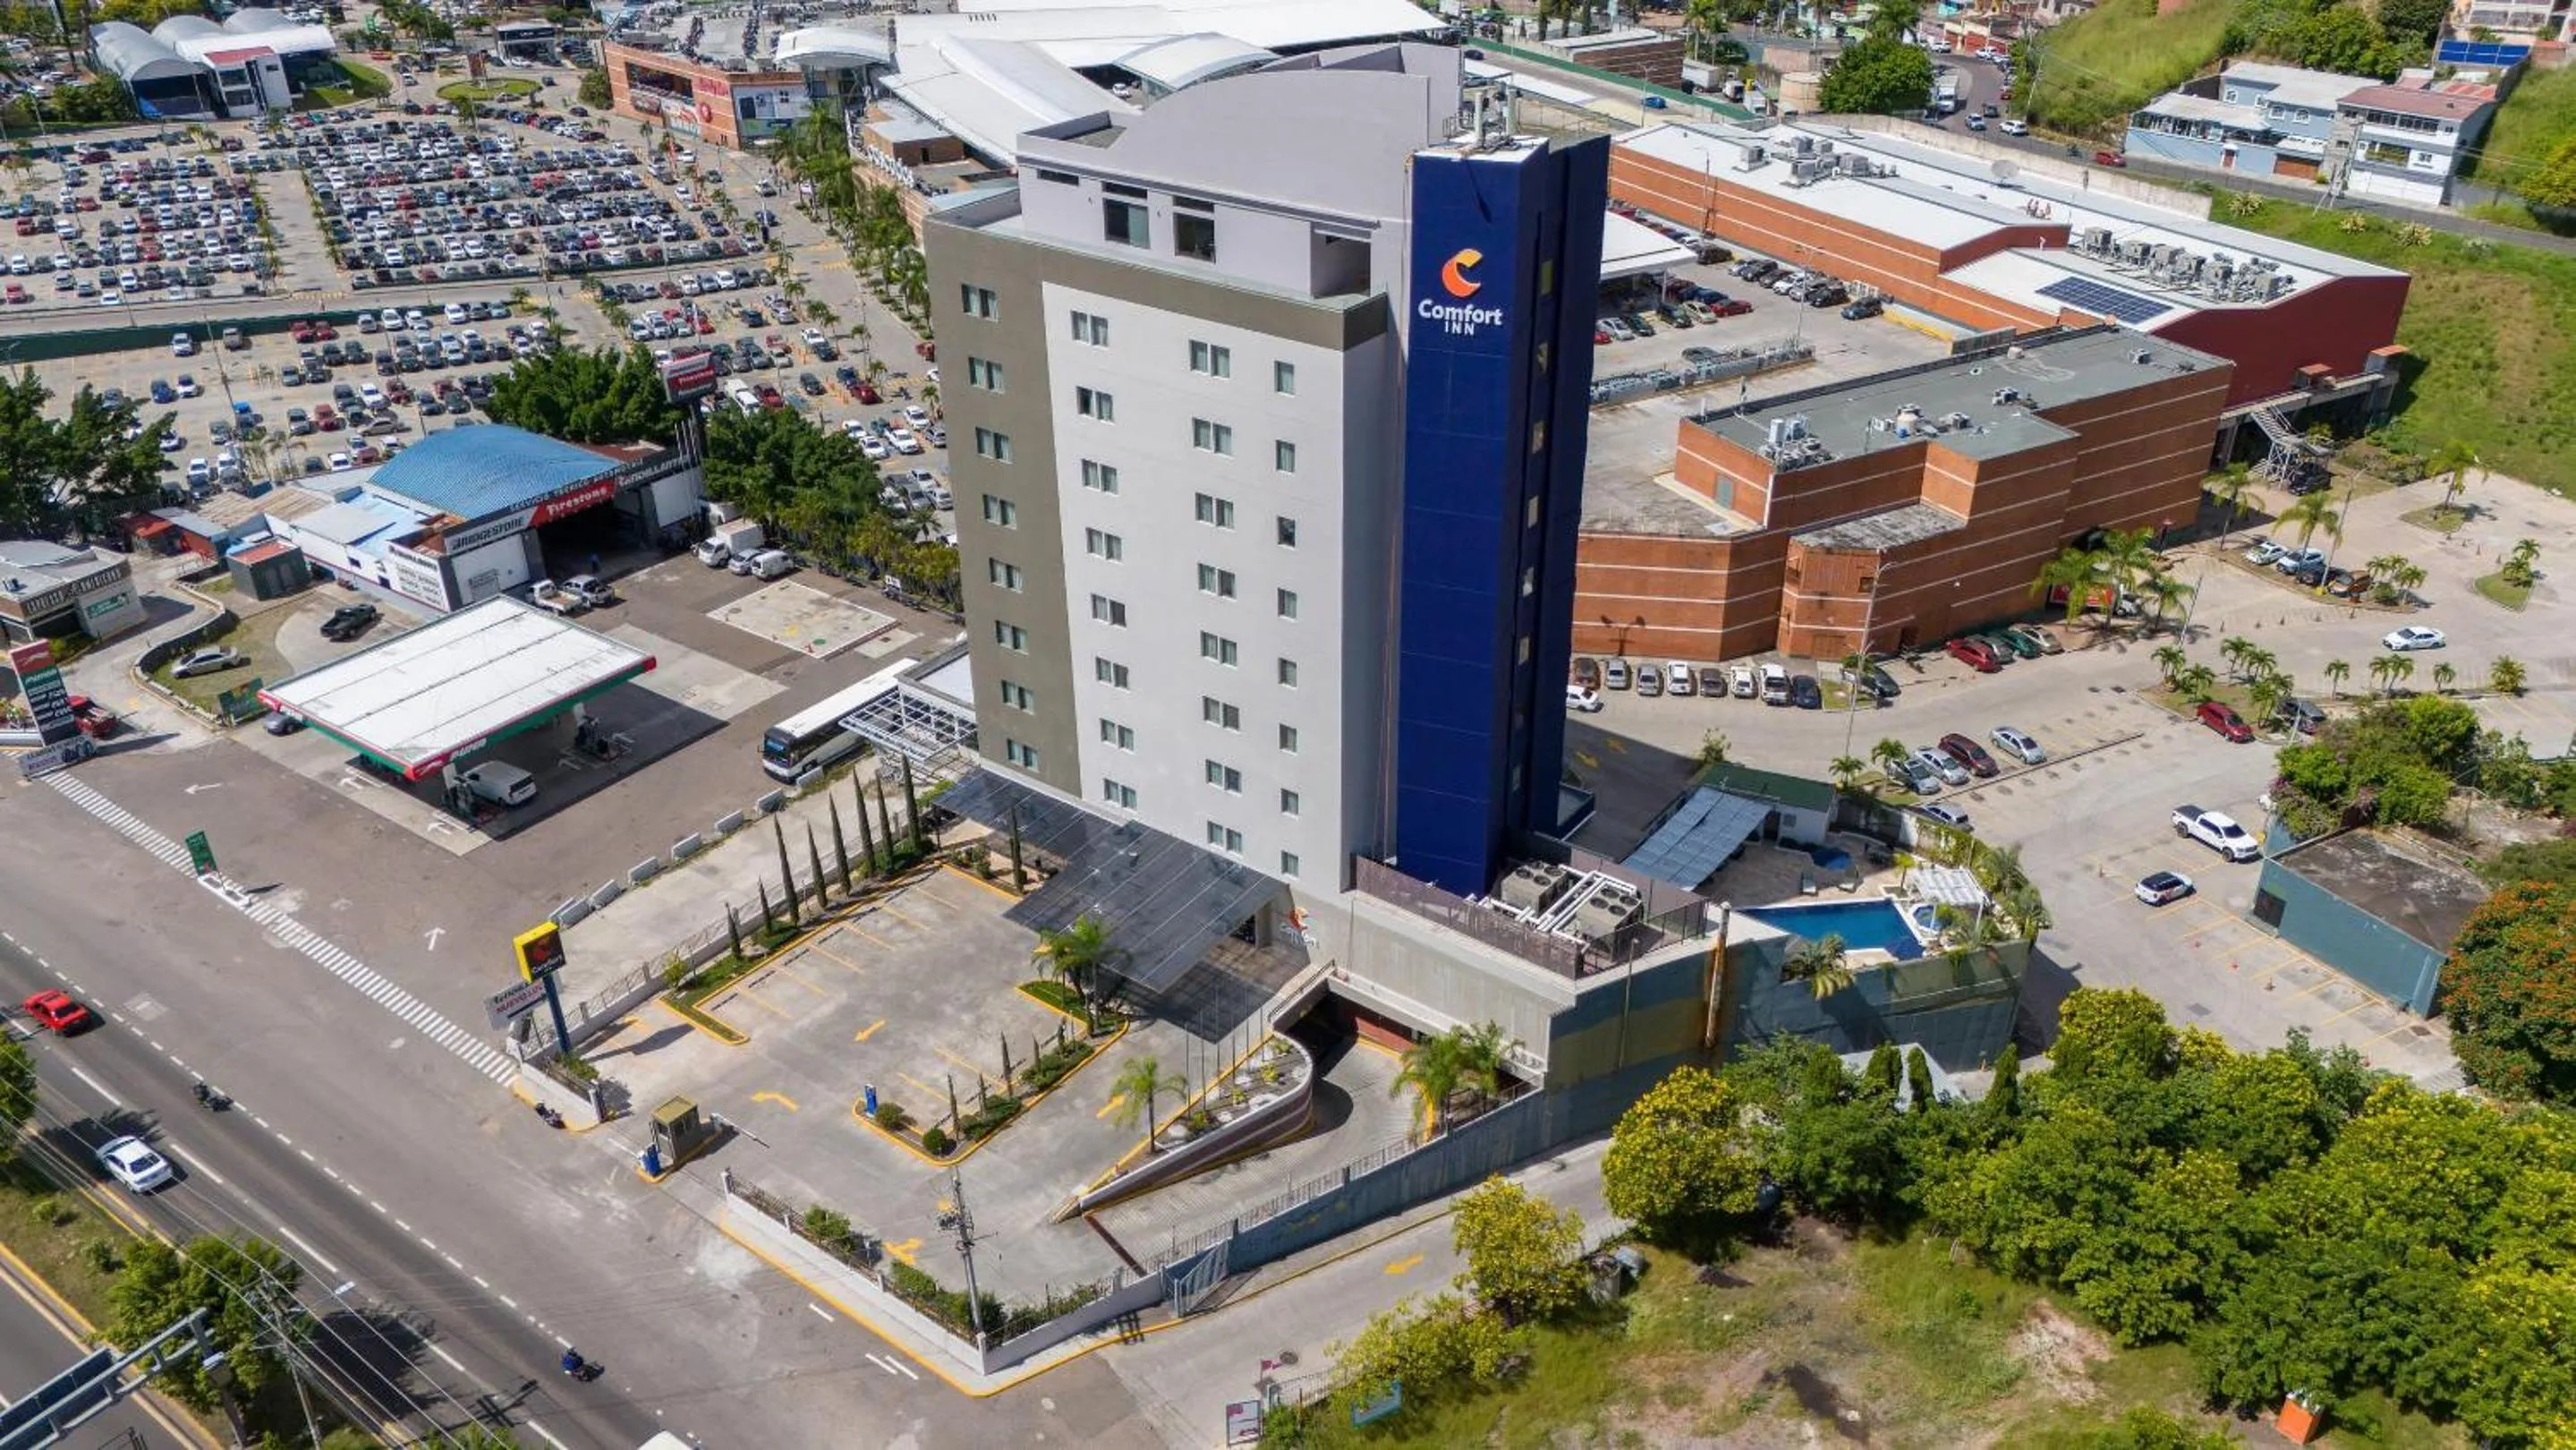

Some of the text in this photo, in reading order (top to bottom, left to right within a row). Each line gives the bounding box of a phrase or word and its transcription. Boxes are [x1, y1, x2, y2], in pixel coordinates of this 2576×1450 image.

[1418, 299, 1503, 326] Comfort
[1445, 321, 1475, 337] INN
[546, 486, 608, 516] Firestone
